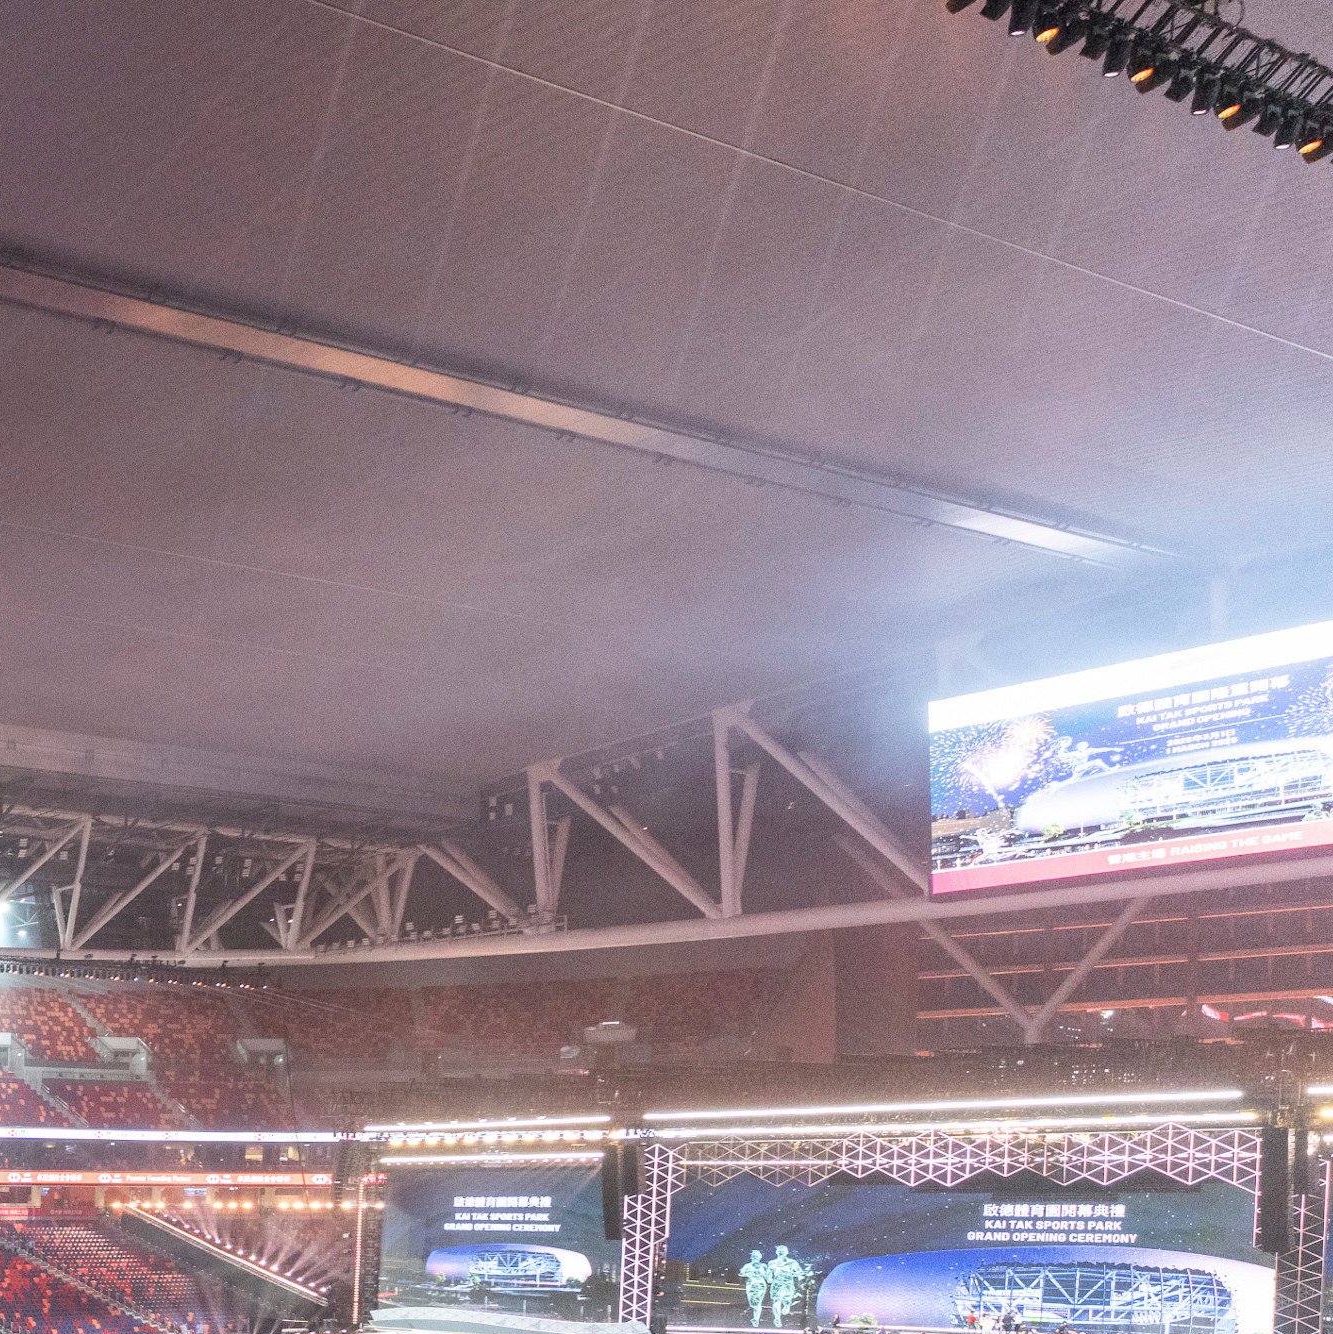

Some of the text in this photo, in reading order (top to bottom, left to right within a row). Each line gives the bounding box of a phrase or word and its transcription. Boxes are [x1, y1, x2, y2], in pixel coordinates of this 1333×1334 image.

[1171, 830, 1305, 857] RAISING THE GAME
[525, 1213, 549, 1221] PARK
[474, 1223, 511, 1231] OPENING
[512, 1224, 561, 1232] CEREMONY
[984, 1220, 1122, 1230] KAI TAK SPORTS PARK
[967, 1231, 1137, 1243] GRAND OPENING CEREMONY
